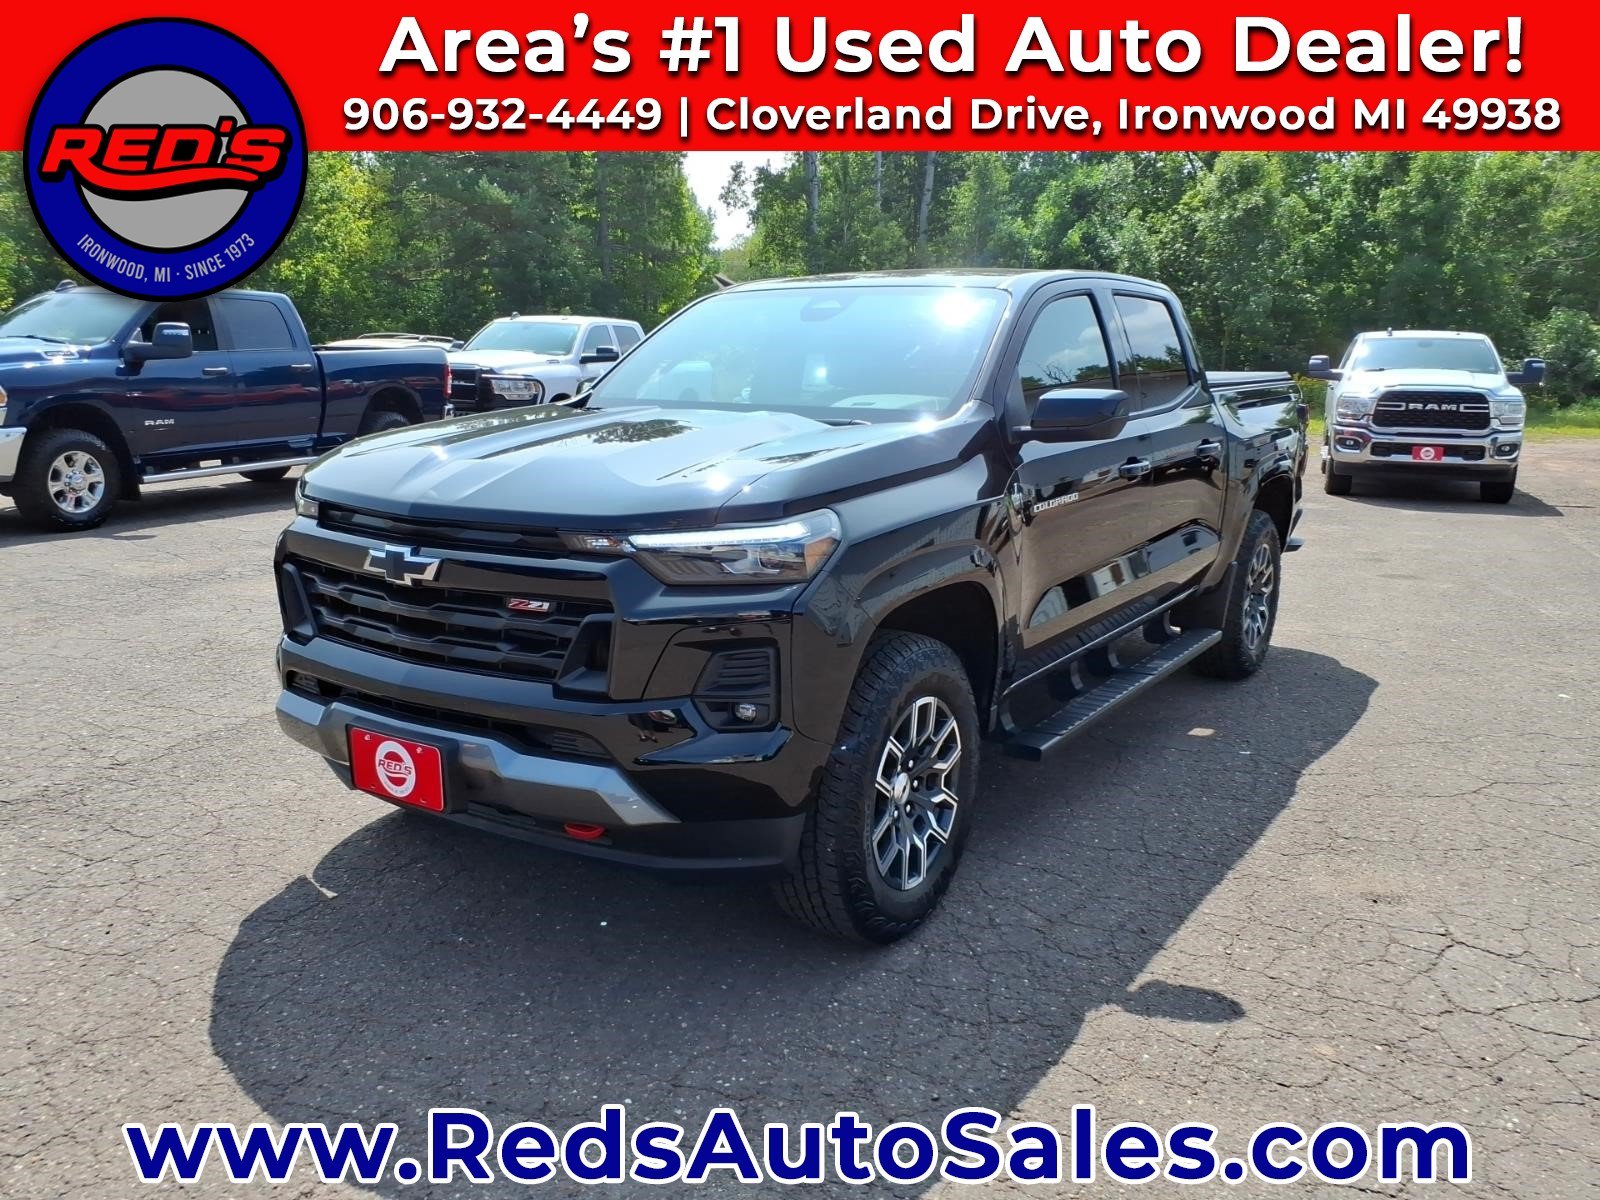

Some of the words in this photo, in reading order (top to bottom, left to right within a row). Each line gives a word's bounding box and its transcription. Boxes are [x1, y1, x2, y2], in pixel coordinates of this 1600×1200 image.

[1408, 402, 1457, 411] RAM
[144, 418, 175, 426] RAM
[1033, 492, 1079, 513] COLORADO
[508, 598, 550, 612] Z71
